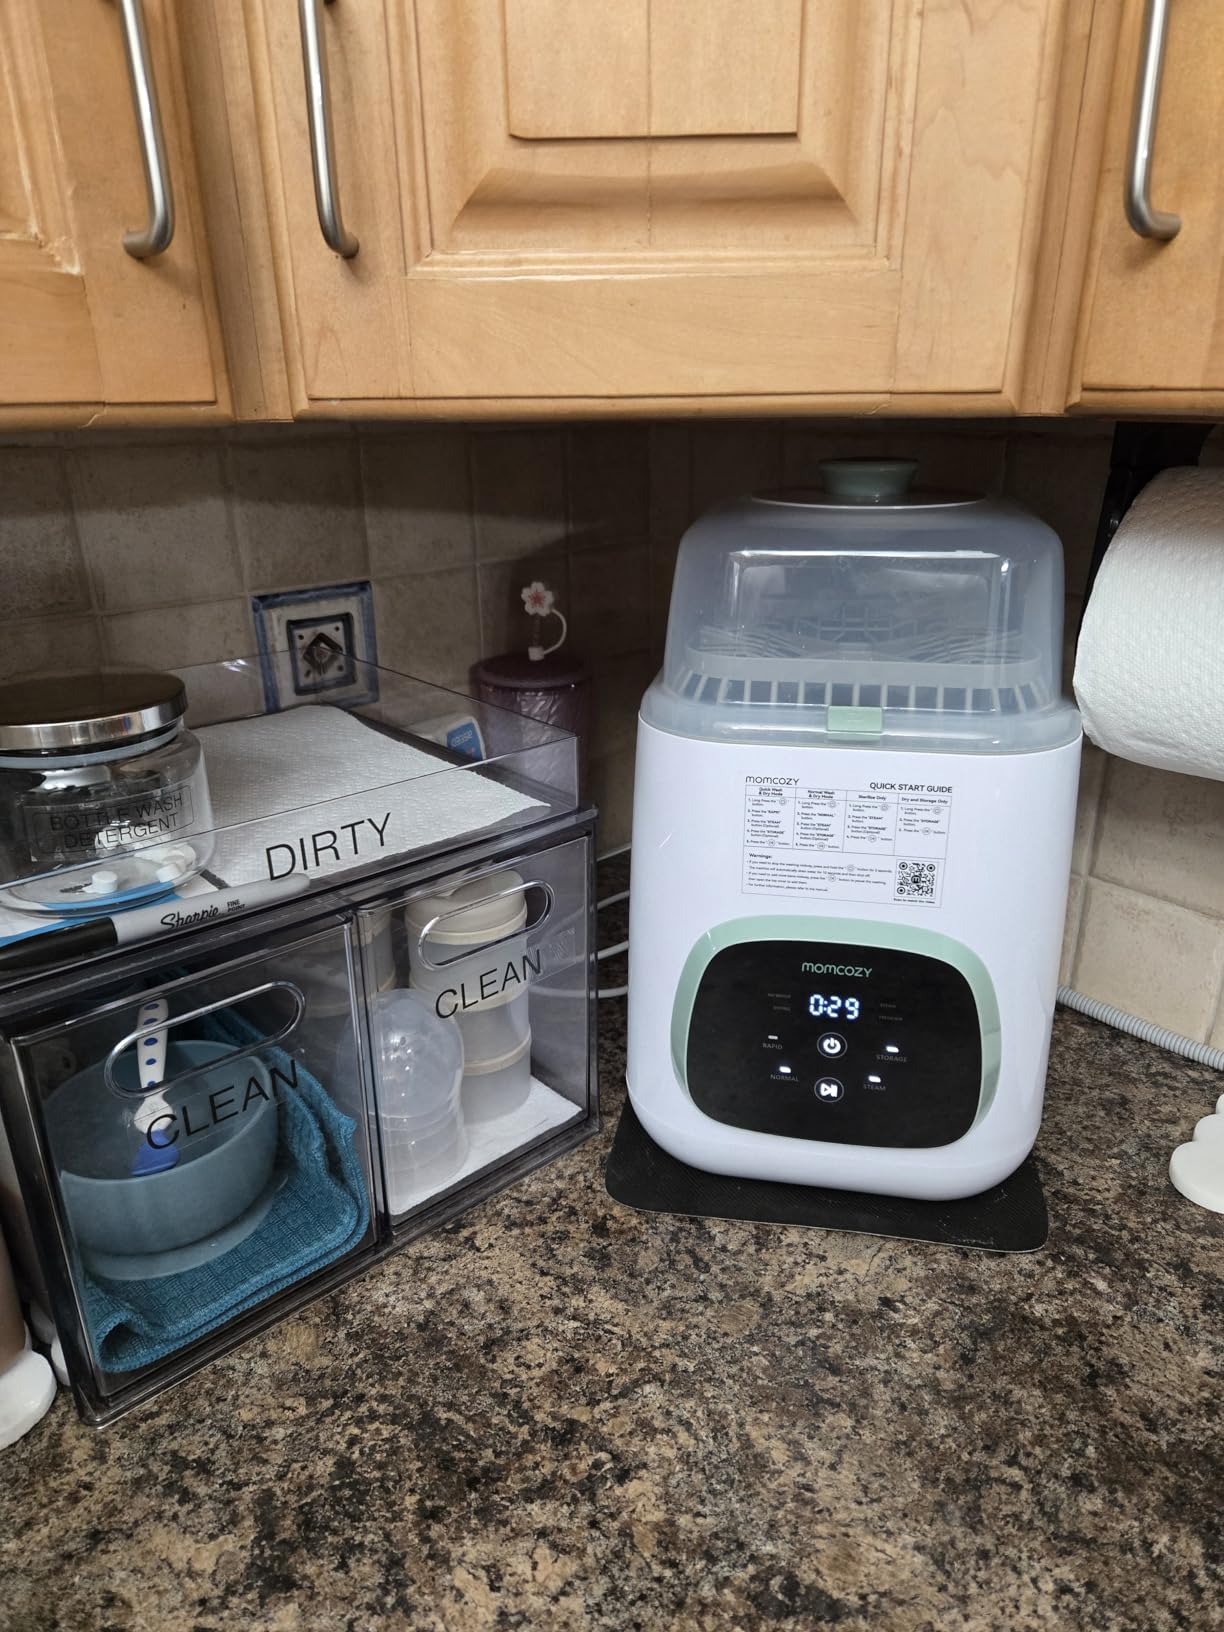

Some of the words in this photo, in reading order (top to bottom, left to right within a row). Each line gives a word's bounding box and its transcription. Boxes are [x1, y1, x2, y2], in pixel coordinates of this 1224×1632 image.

[870, 782, 896, 790] QUICK
[898, 784, 925, 792] START
[50, 807, 128, 831] BOTTLE
[136, 792, 183, 818] WASH
[63, 813, 178, 849] DETERGENT
[265, 812, 391, 881] DIRTY
[160, 905, 218, 928] Sharpie
[228, 904, 245, 912] POINT
[435, 949, 541, 1019] CLEAN
[809, 994, 859, 1019] 0:29
[147, 1059, 297, 1149] CLEAN
